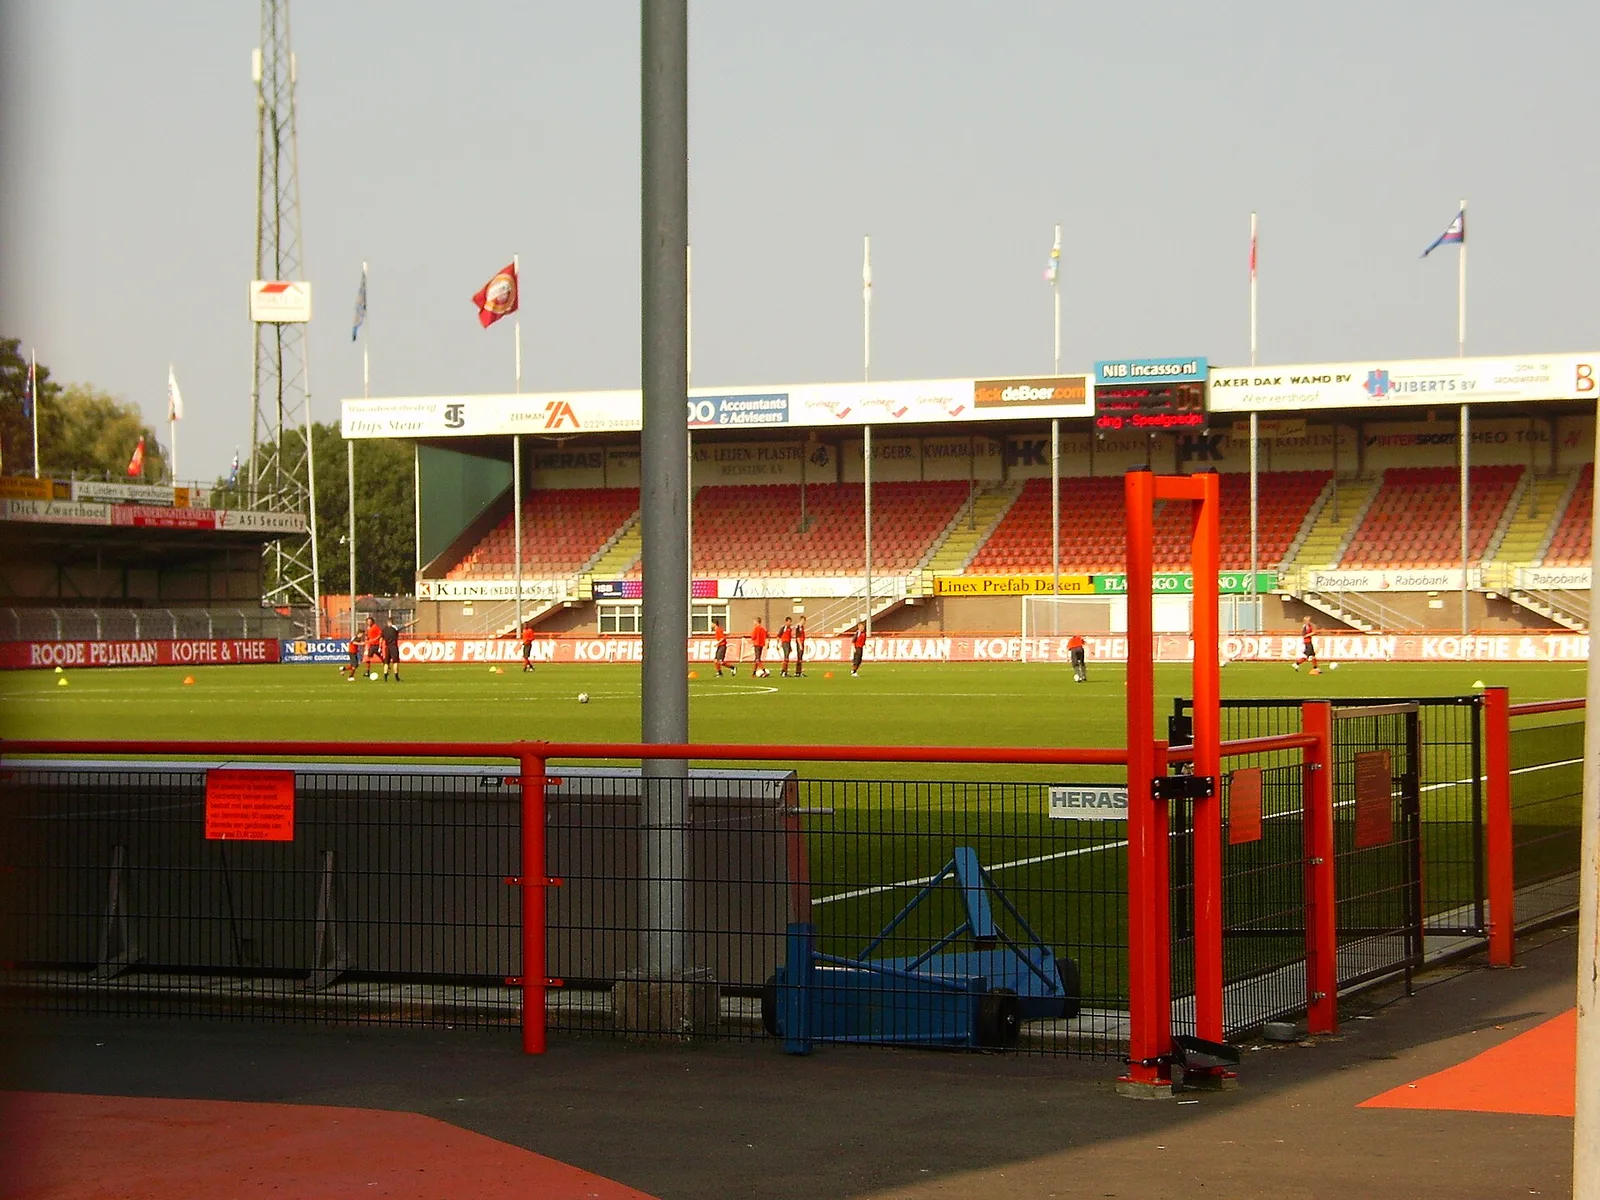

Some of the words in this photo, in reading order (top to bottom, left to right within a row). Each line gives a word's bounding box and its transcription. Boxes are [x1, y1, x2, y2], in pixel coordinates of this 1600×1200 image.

[1103, 364, 1127, 378] NIB
[720, 399, 787, 412] Accountants
[510, 412, 545, 422] ZEEMAN
[720, 413, 730, 424] &
[730, 411, 783, 424] Adviseurs
[1471, 430, 1508, 445] HEO
[260, 516, 304, 530] Security
[938, 580, 978, 593] Linex
[983, 578, 1030, 592] Prefab
[1316, 575, 1369, 588] Rabobank
[1395, 573, 1449, 587] Rabobank
[1532, 573, 1589, 585] Rabobank
[31, 643, 85, 665] ROODE
[90, 642, 158, 664] PELIKAAN
[171, 642, 217, 661] KOFFIE
[221, 642, 231, 661] &
[234, 641, 266, 660] THEE
[284, 641, 351, 655] NRBCC.N
[399, 641, 456, 661] OODE
[574, 640, 643, 661] KOFFIE
[852, 638, 952, 661] ELIKAAN
[1422, 637, 1509, 660] KOFFIE
[1516, 638, 1536, 659] &
[313, 654, 351, 662] communica
[1052, 791, 1128, 809] HERAS
